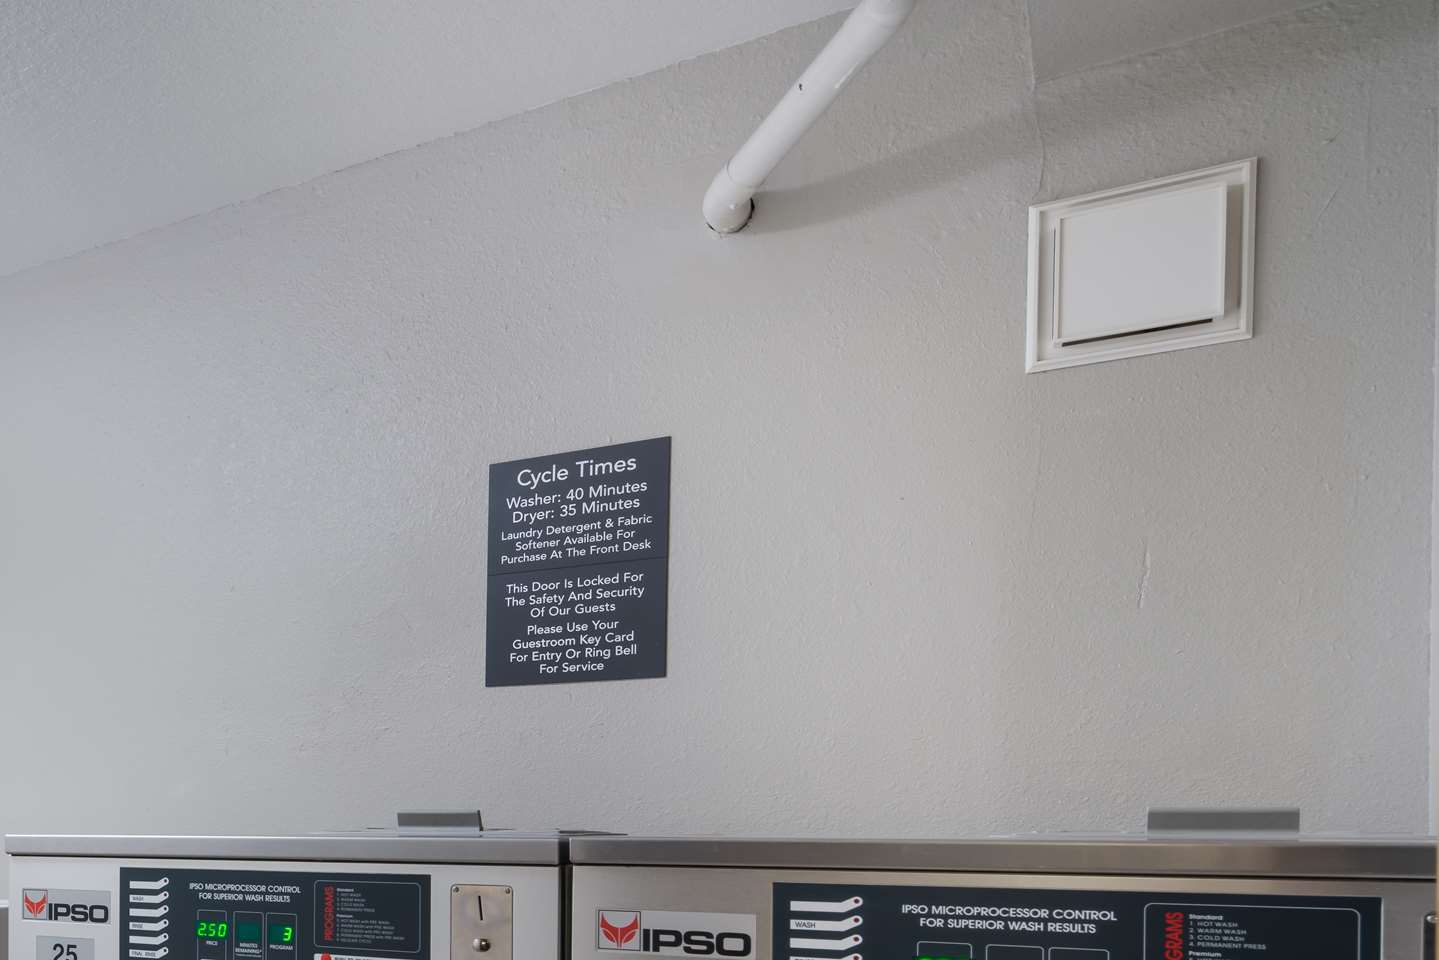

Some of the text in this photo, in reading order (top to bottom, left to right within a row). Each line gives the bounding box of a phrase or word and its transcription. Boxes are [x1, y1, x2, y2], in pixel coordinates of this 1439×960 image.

[517, 458, 637, 489] Cycle Times
[506, 481, 647, 509] Washer: 40 Minutes
[512, 498, 640, 524] Dryer: 35 Minutes
[502, 515, 652, 541] Laundry Detergent & Fabric
[516, 530, 635, 551] Softener Available For
[501, 540, 651, 564] Purchase At The Front Desk
[507, 572, 643, 593] This Door Is Locked For
[505, 586, 644, 607] The Safety And Security
[530, 602, 616, 618] Of Our Guests
[527, 621, 619, 635] Please Use Your
[513, 631, 634, 649] Guestroom Key Card
[510, 644, 637, 662] For Entry Or Ring Bell
[540, 662, 604, 674] For Service
[205, 883, 266, 893] MICROPROCESSOR
[268, 885, 301, 893] CONTROL
[265, 895, 290, 903] RESULTS
[49, 903, 108, 923] IPSO
[324, 885, 334, 941] PROGRAMS
[902, 905, 1117, 921] IPSO MICROPROCESSOR CONTROL
[198, 923, 227, 937] 2.50
[283, 928, 292, 941] 3
[920, 918, 1096, 933] FOR SUPERIOR WASH RESULTS
[643, 929, 751, 957] IPSO
